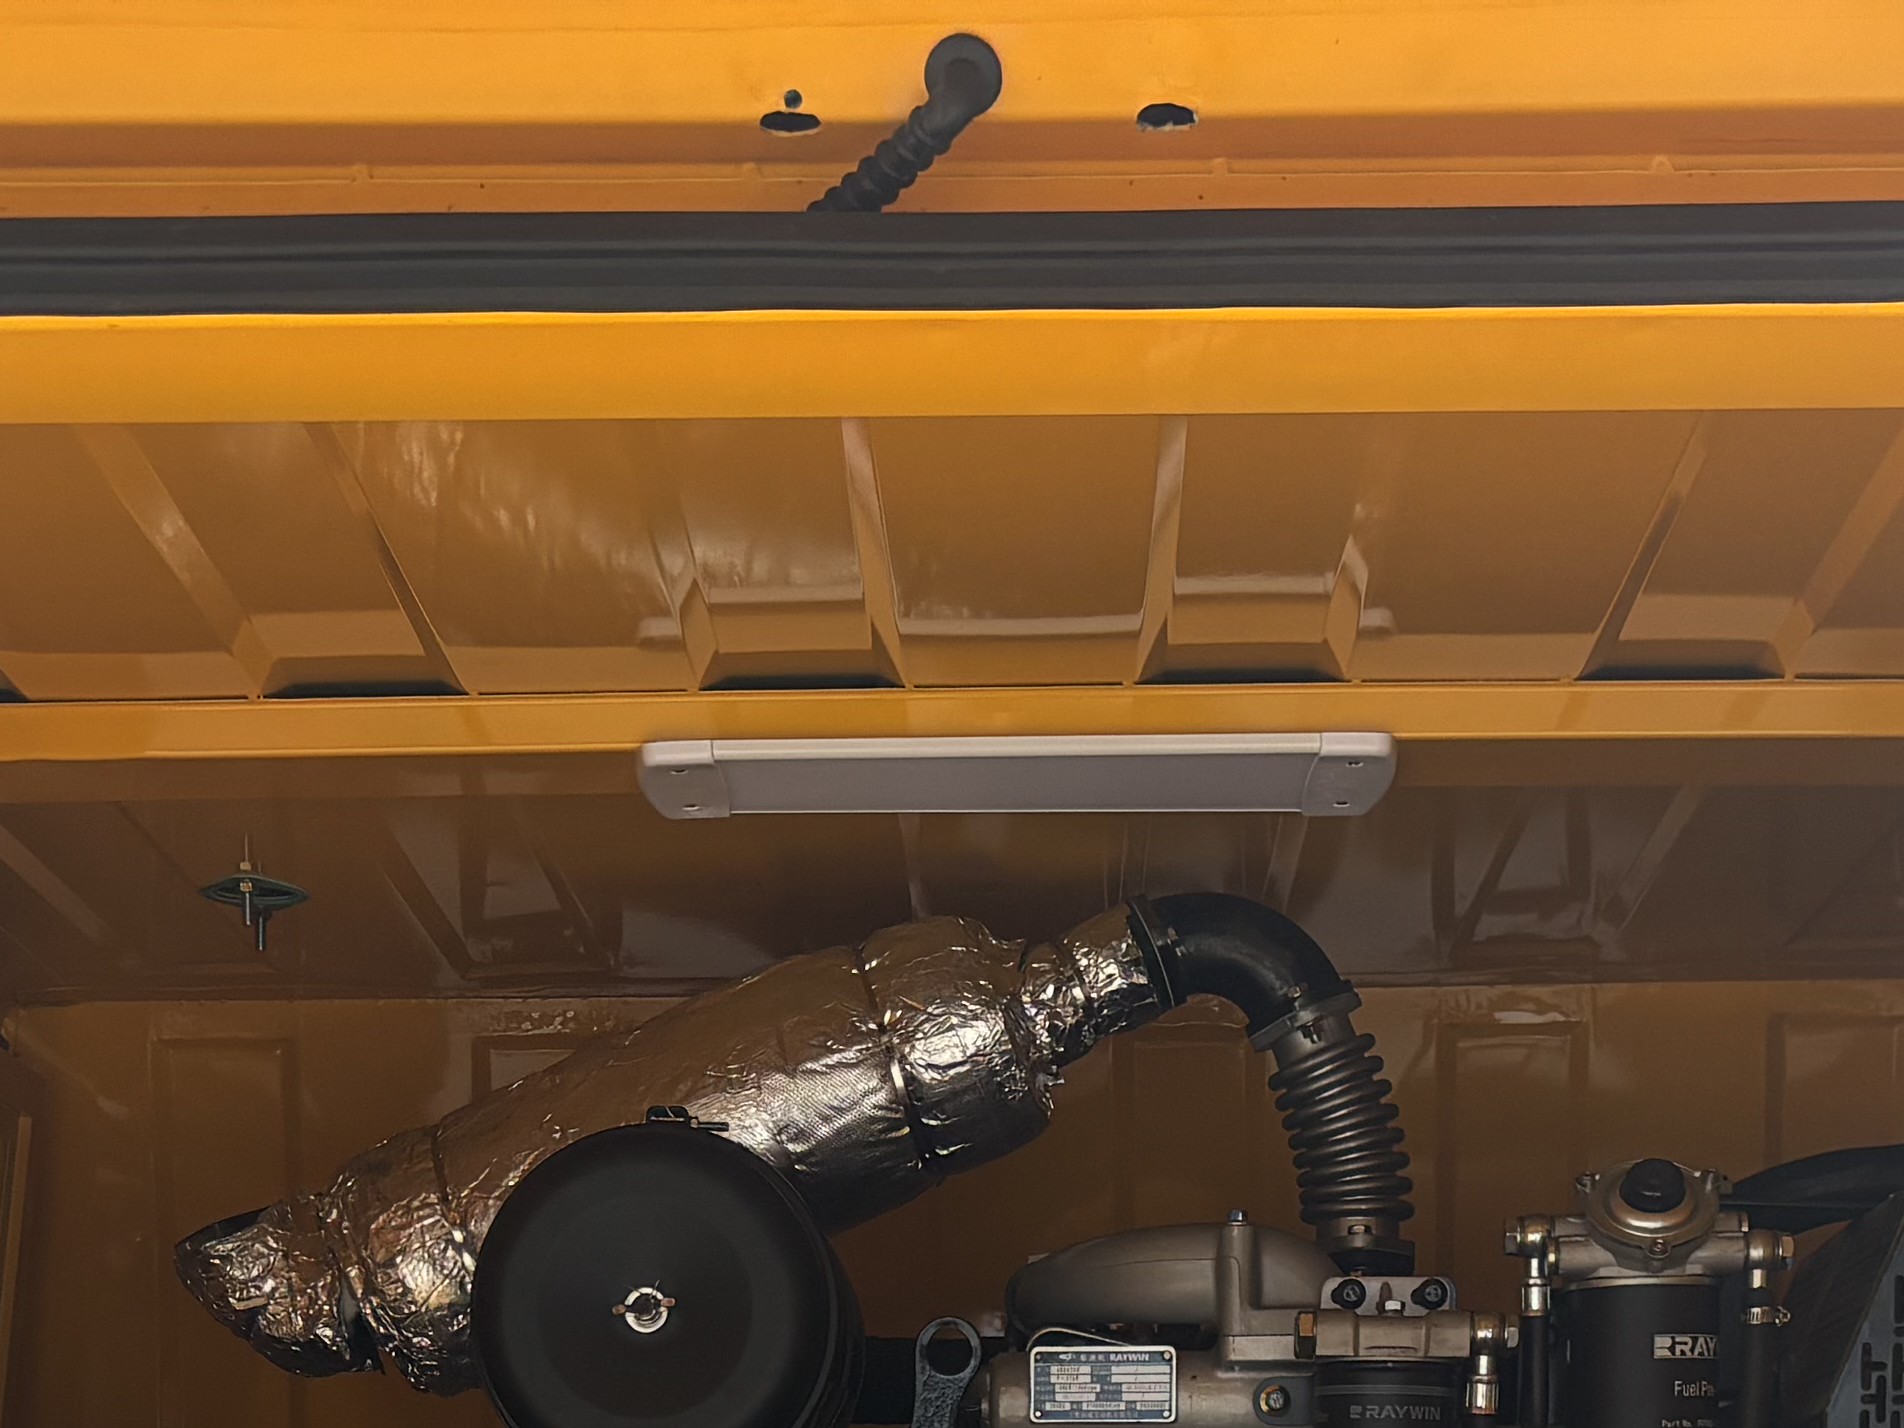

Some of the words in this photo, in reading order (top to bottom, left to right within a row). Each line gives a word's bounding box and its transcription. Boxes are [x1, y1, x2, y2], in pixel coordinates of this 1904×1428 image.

[1109, 1352, 1150, 1362] RAYWIN
[1674, 1380, 1700, 1397] Fuel
[1364, 1404, 1442, 1422] RAYWIN
